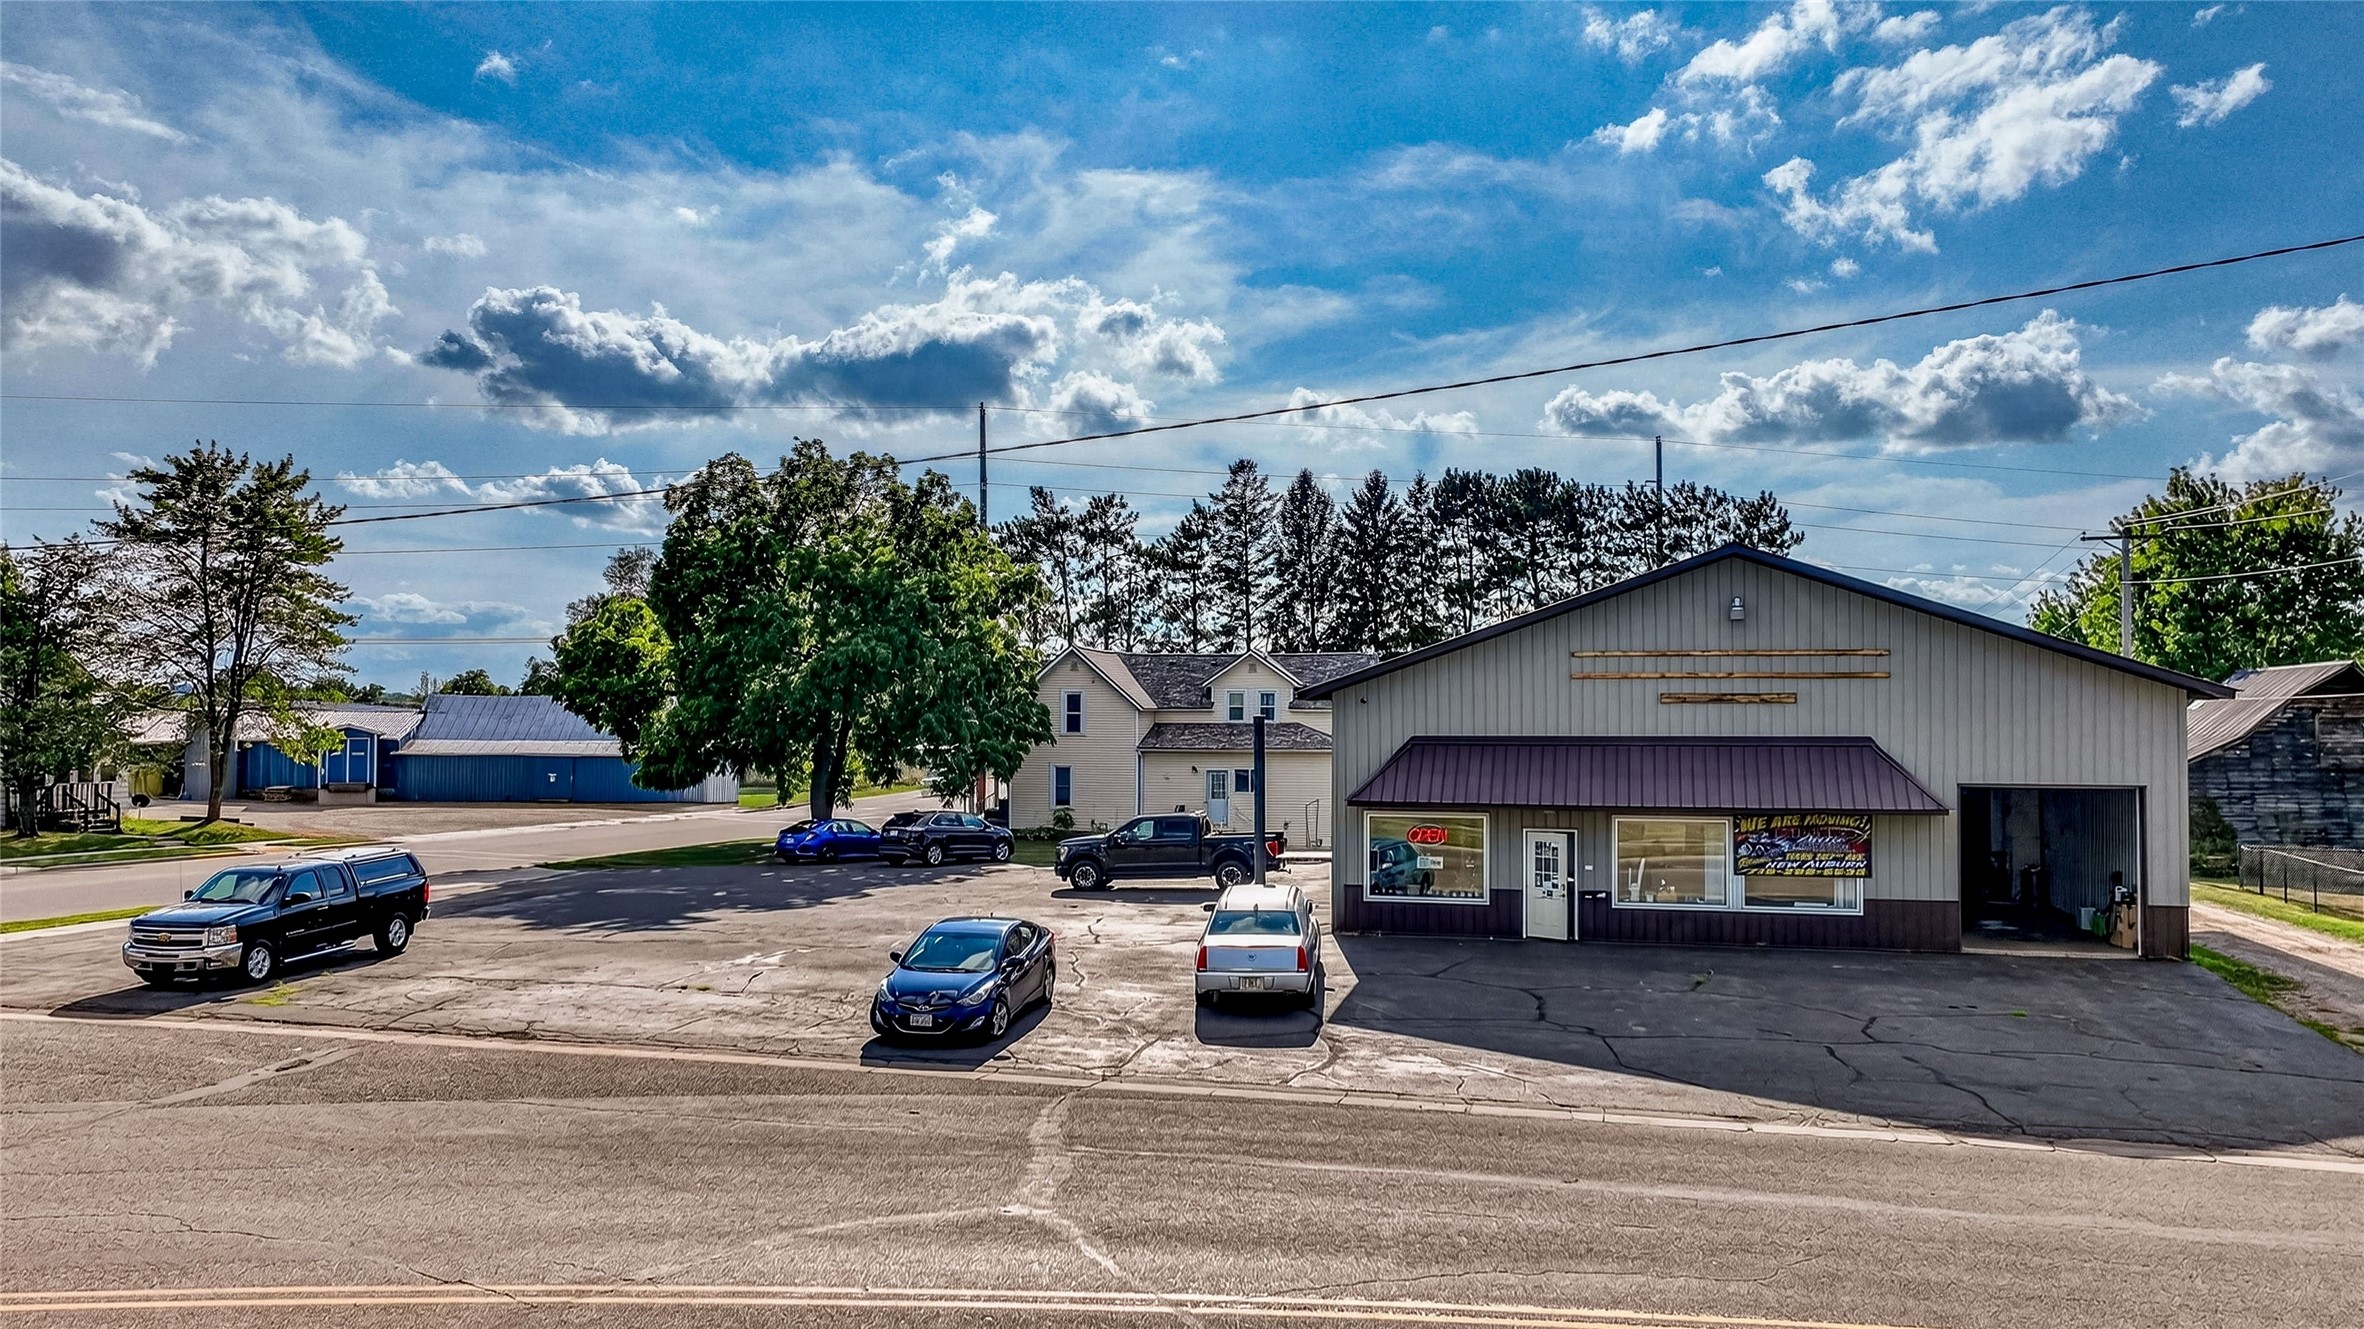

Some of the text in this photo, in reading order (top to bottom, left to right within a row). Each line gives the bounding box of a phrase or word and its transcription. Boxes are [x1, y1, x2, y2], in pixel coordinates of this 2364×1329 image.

[1740, 813, 1868, 832] WE ARE MOVING!
[1408, 827, 1448, 843] OPEN
[1765, 861, 1800, 869] NEW
[1803, 860, 1867, 868] AUBURN
